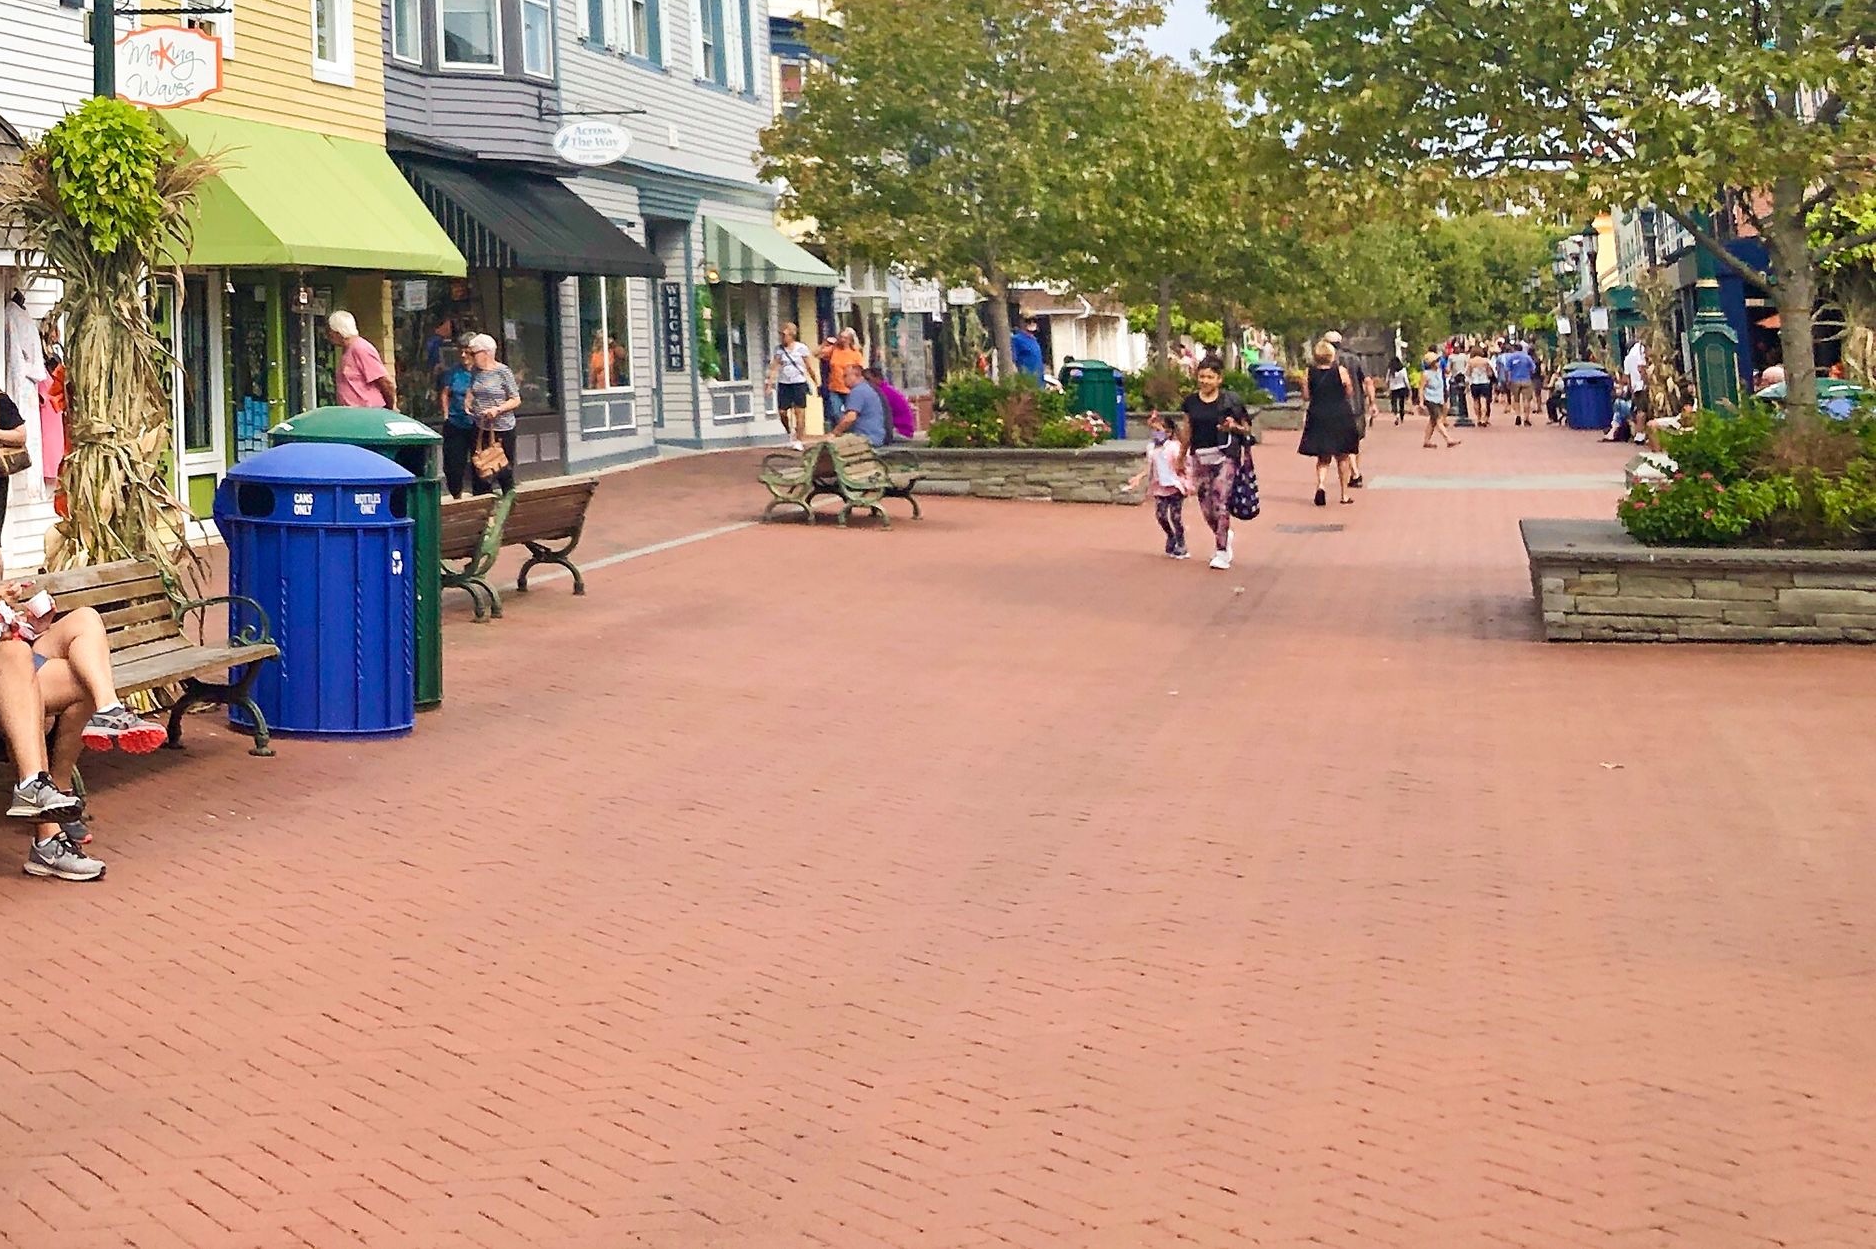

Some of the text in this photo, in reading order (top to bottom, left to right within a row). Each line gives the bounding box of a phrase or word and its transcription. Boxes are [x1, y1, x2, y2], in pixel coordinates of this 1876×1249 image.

[125, 73, 195, 102] Waves
[665, 284, 682, 367] WELCOME
[294, 493, 314, 504] CANS
[354, 493, 381, 504] BOTTLES
[294, 504, 313, 515] ONLY
[360, 504, 376, 515] ONLY
